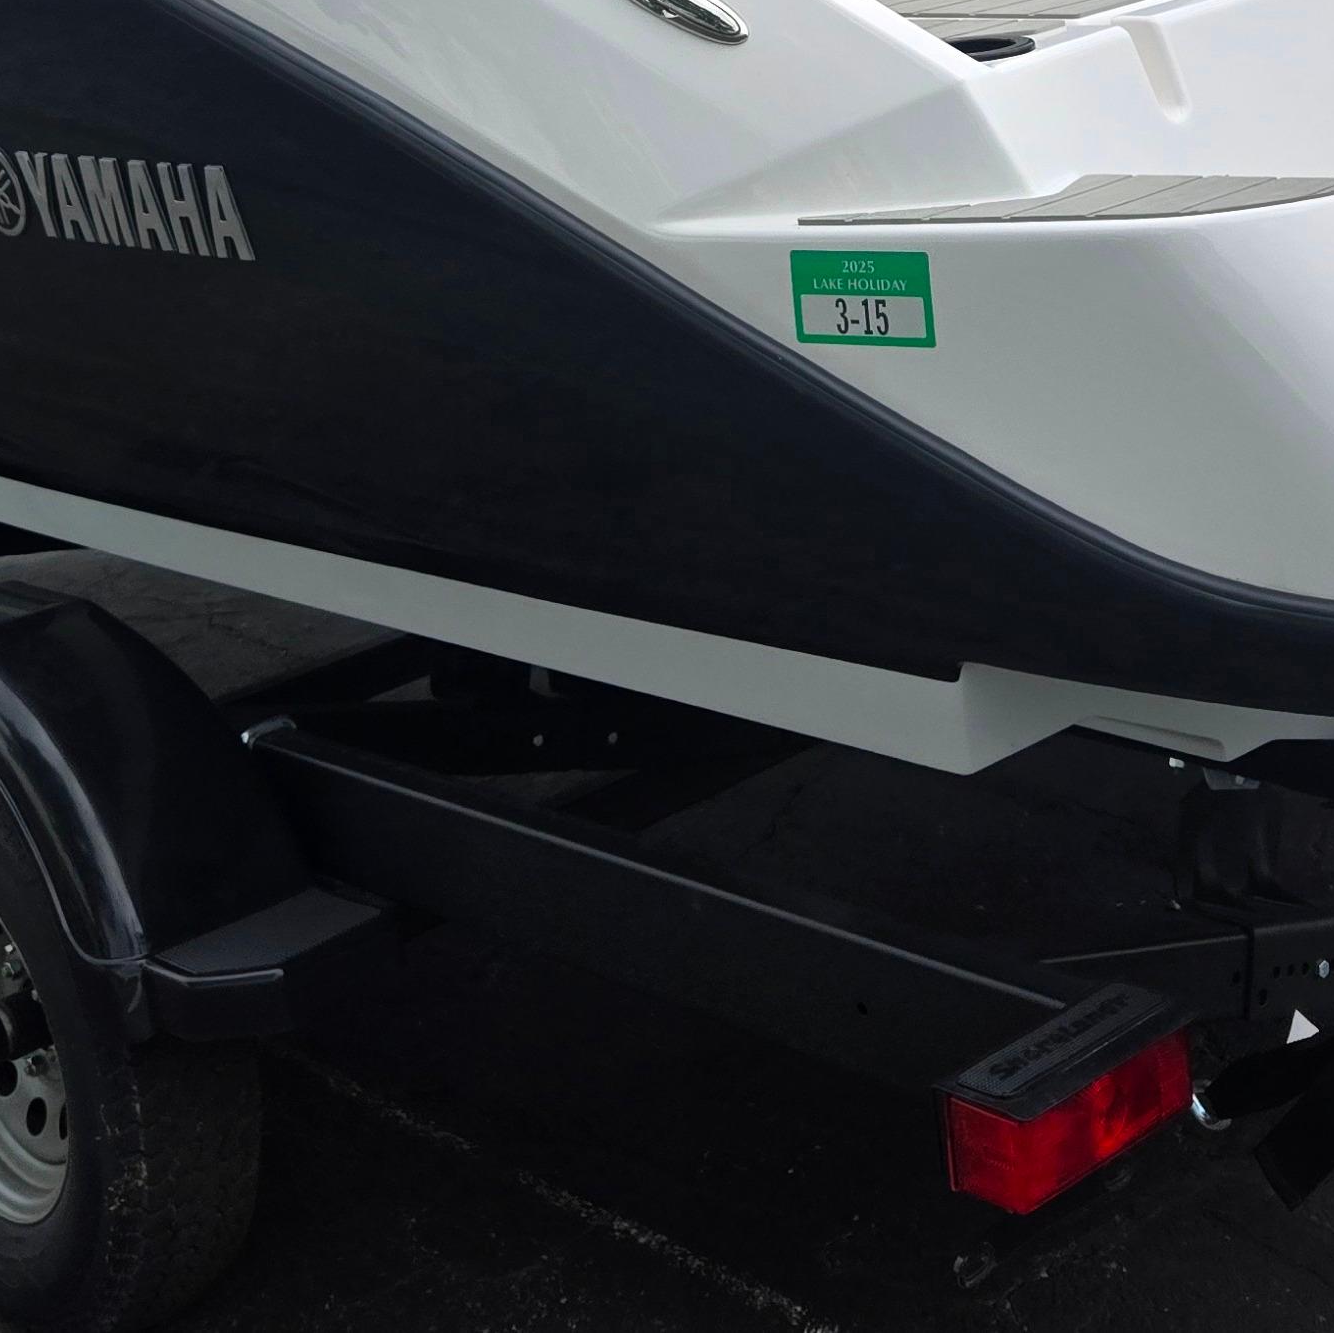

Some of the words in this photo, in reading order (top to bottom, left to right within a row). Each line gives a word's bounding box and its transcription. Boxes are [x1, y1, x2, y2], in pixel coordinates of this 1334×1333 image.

[15, 150, 257, 261] YAMAHA
[841, 260, 875, 274] 2025
[813, 278, 844, 290] LAKE
[847, 278, 908, 292] HOLIDAY
[835, 297, 890, 336] 3-15
